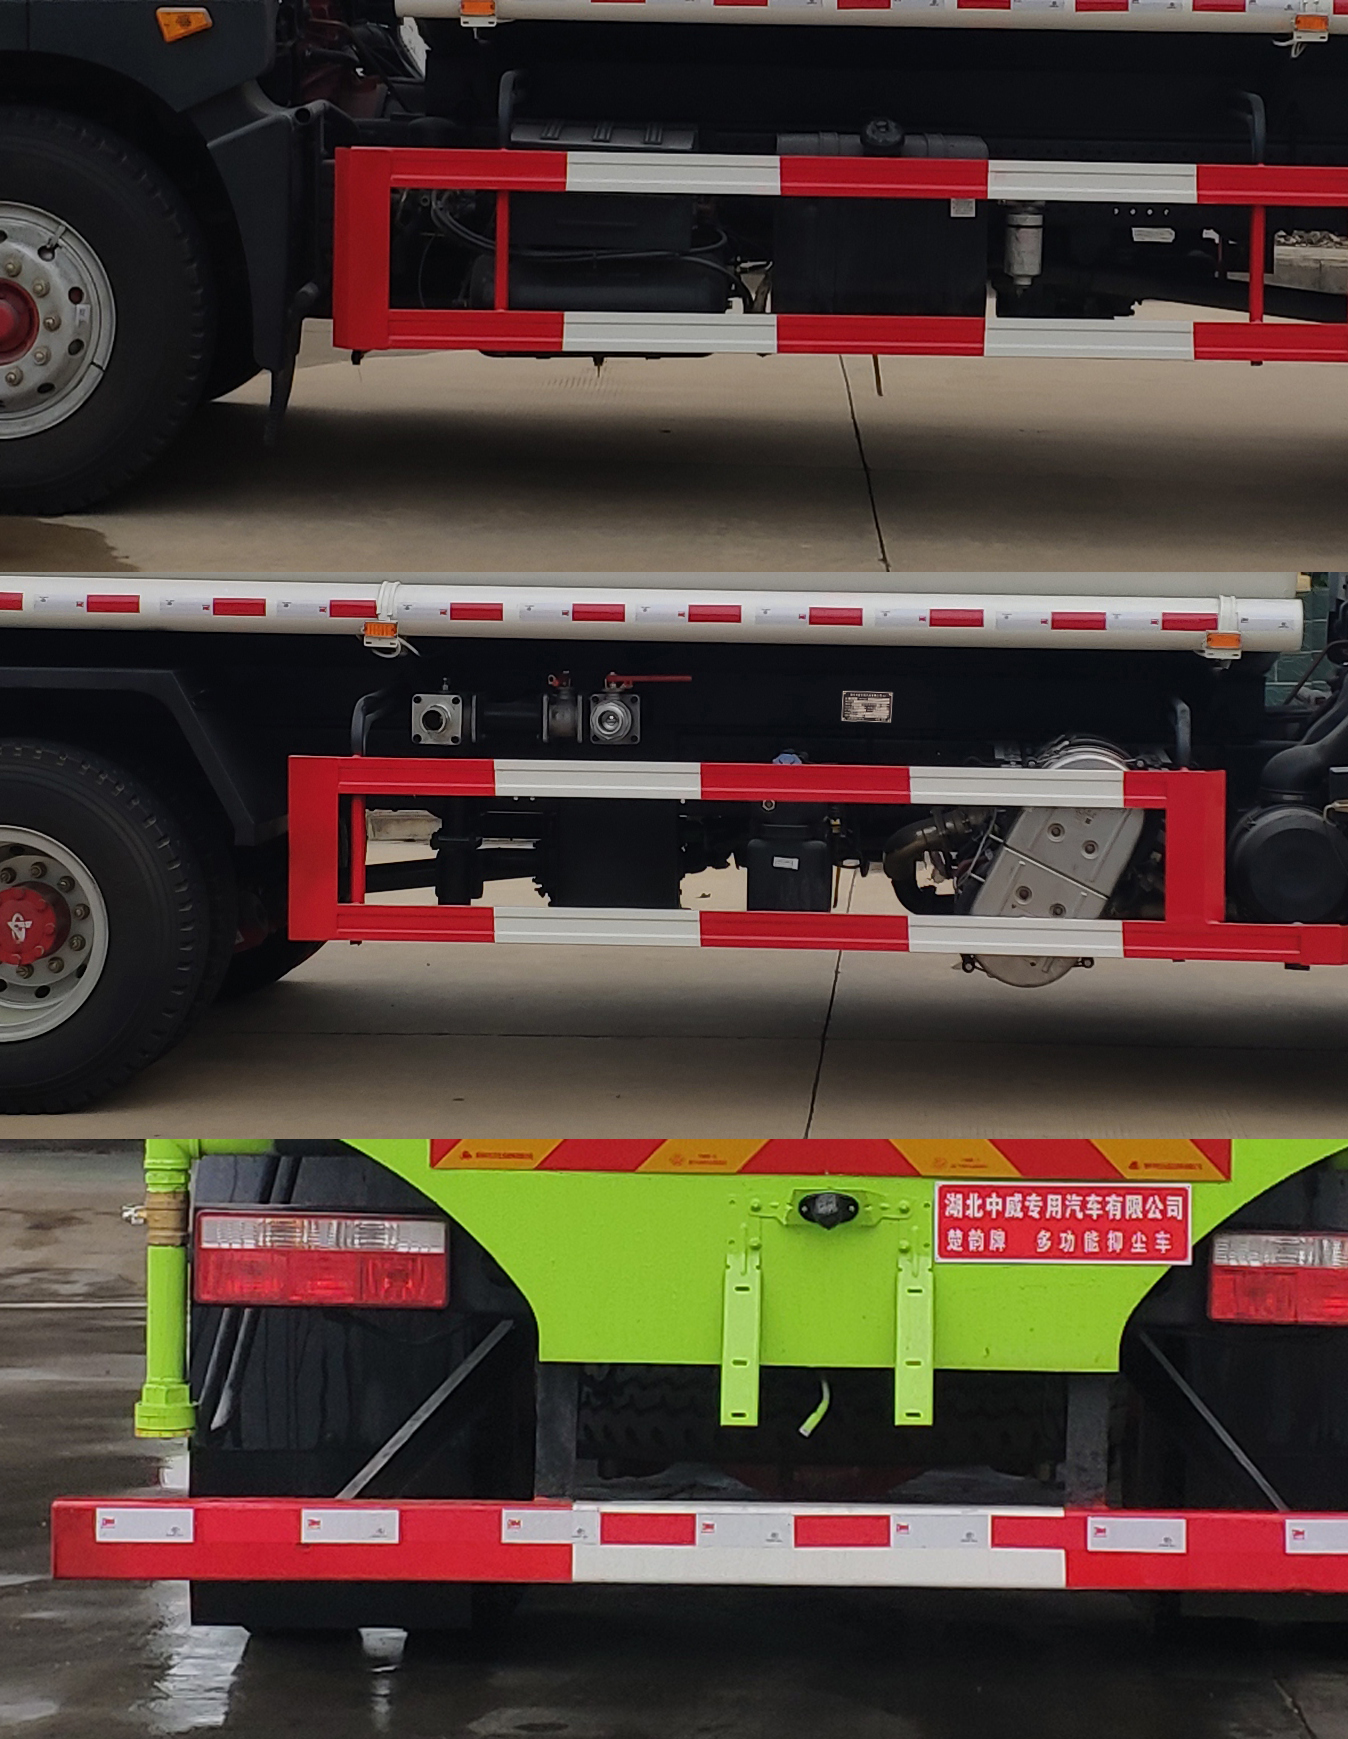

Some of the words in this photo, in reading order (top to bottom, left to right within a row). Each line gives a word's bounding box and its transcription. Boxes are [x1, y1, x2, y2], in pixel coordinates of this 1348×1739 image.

[944, 1192, 1183, 1220] 湖北中威专用汽车有限公司
[1036, 1229, 1171, 1254] 多功能抑尘车
